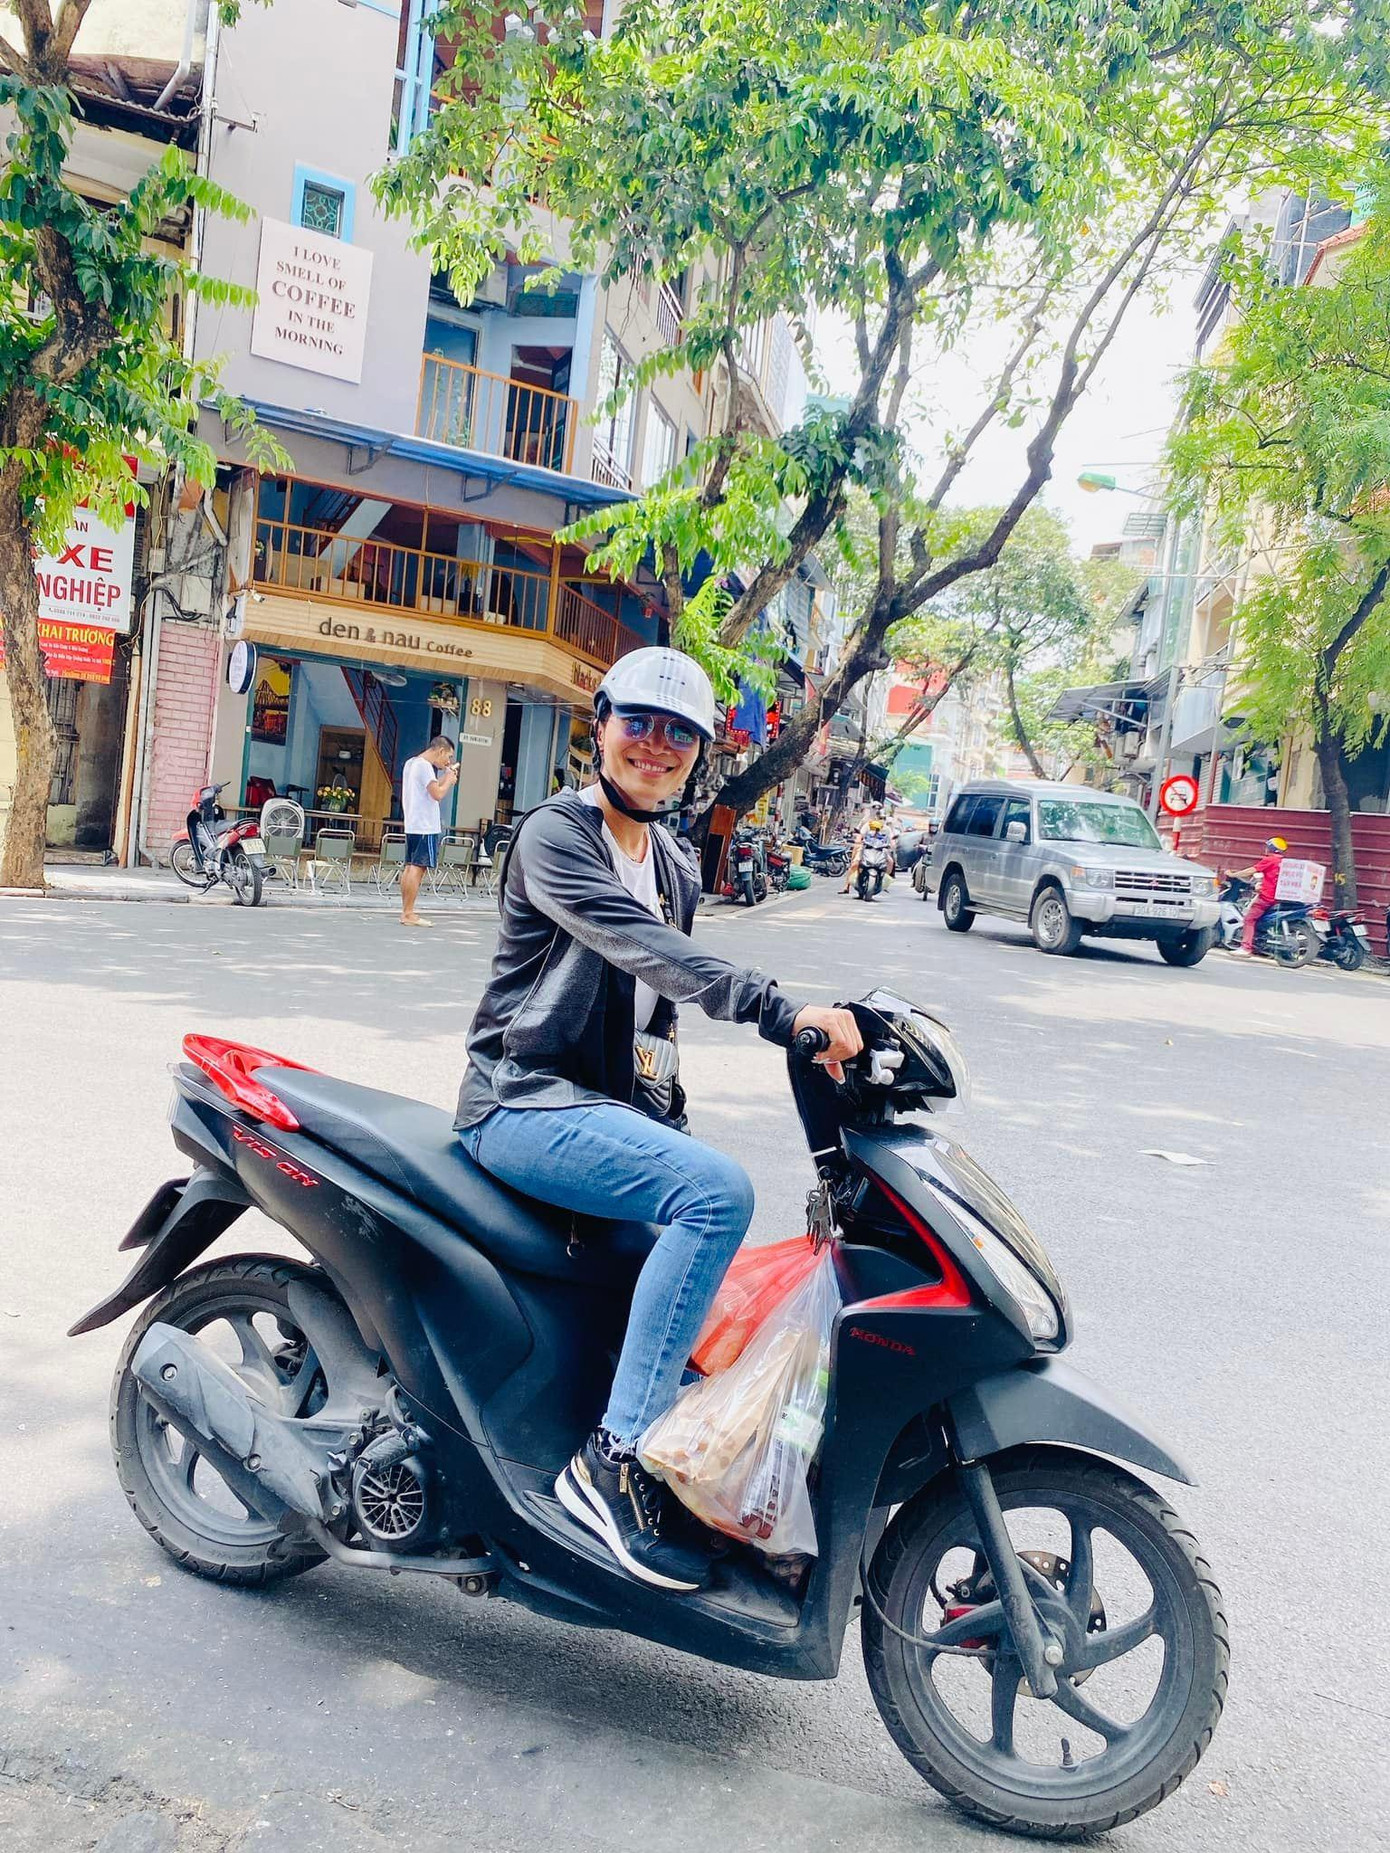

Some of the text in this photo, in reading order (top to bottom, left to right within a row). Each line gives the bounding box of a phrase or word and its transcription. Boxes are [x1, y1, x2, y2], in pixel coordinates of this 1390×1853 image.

[294, 246, 341, 270] I LOVE
[276, 261, 347, 290] SMELL OF
[272, 280, 356, 319] COFFEE
[289, 310, 335, 333] IN THE
[275, 326, 344, 355] MORNING
[56, 543, 114, 573] XE
[37, 572, 121, 612] NGHIỆP
[319, 616, 360, 640] den
[365, 627, 377, 643] &
[383, 630, 420, 650] nau
[471, 698, 492, 718] 88
[232, 1125, 319, 1187] VISON
[849, 1327, 916, 1356] HONDA
